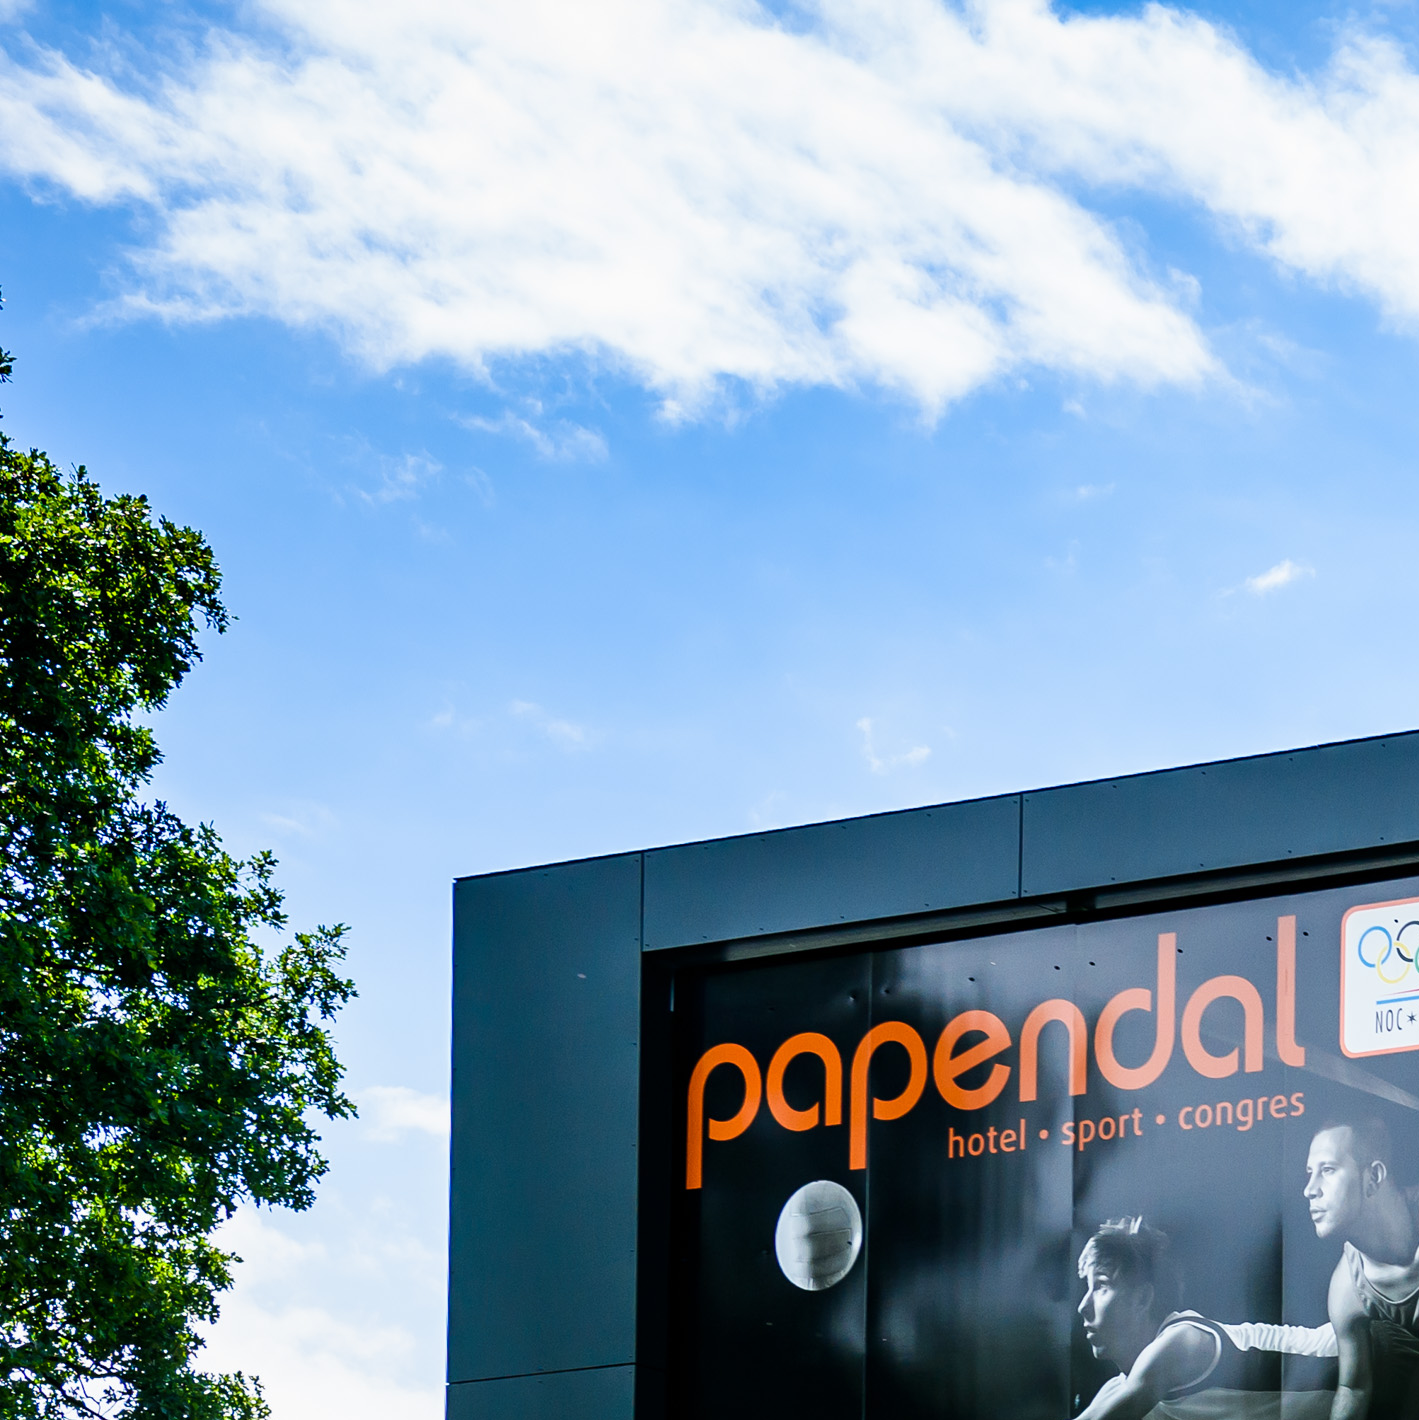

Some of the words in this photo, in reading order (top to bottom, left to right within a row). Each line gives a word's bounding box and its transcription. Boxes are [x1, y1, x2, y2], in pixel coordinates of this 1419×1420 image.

[685, 916, 1305, 1190] papendal
[1375, 1007, 1403, 1033] NOC
[948, 1118, 1027, 1159] hotel
[1061, 1109, 1143, 1152] sport
[1178, 1093, 1305, 1131] congres
